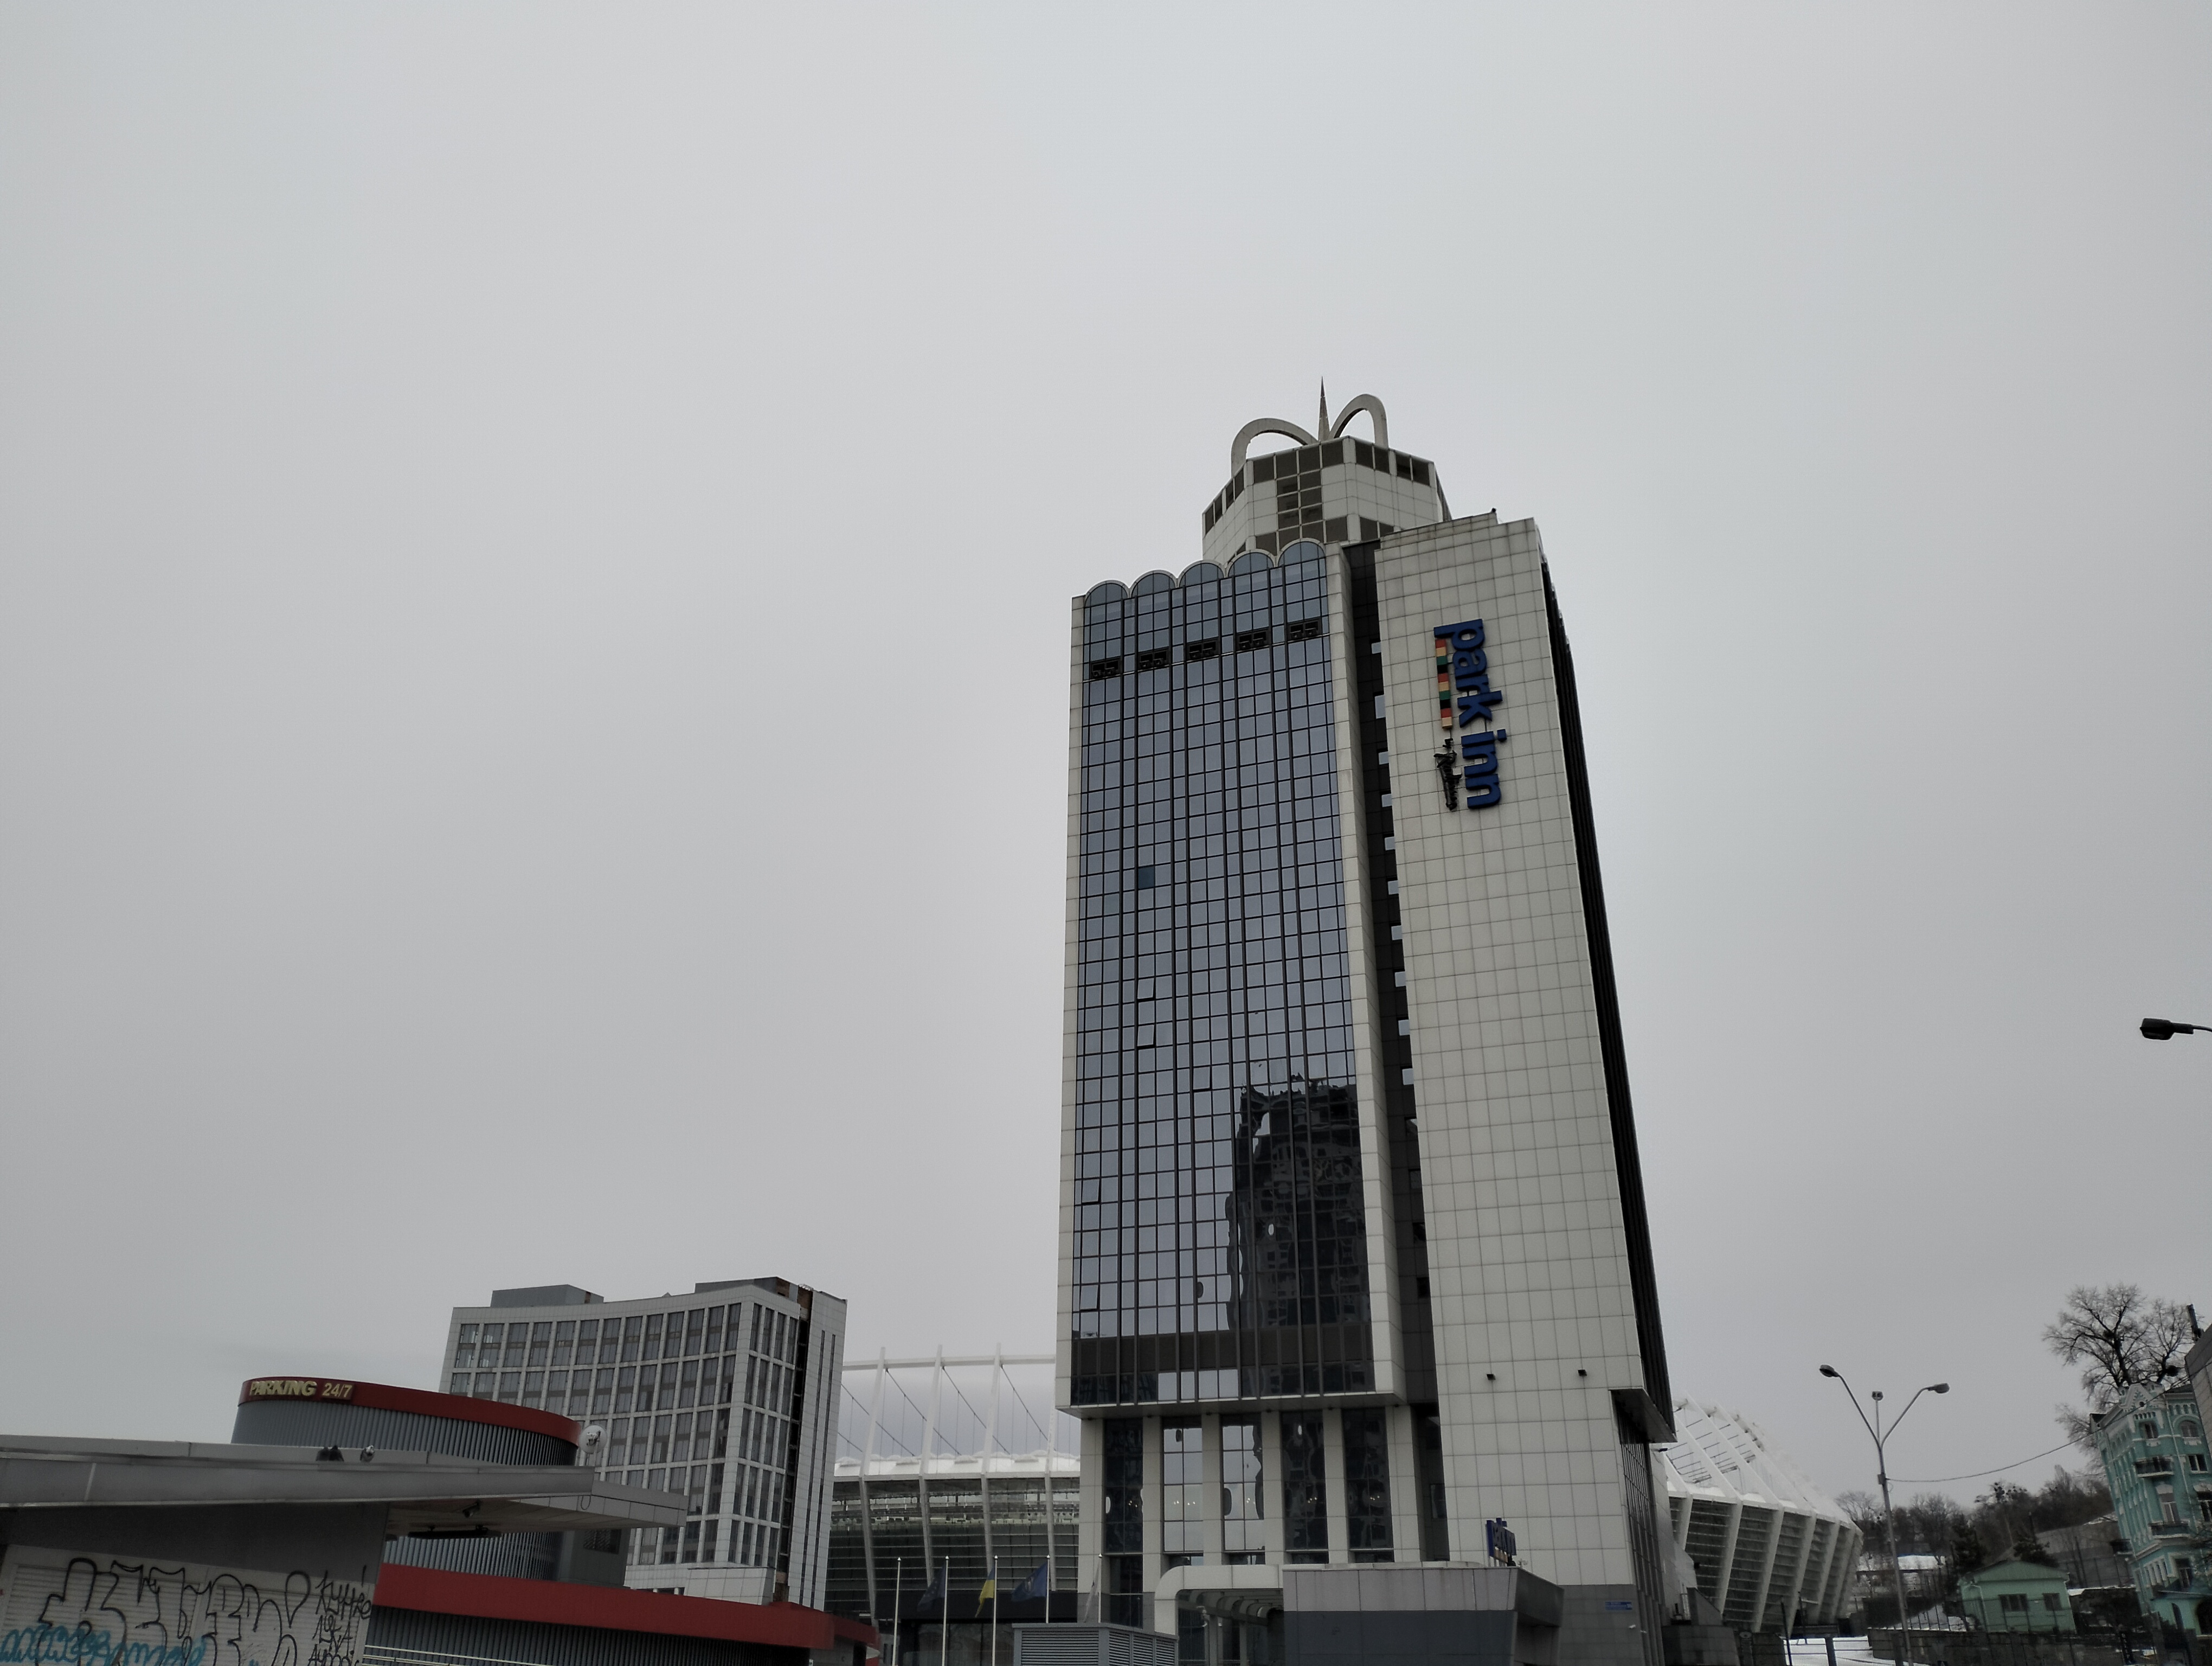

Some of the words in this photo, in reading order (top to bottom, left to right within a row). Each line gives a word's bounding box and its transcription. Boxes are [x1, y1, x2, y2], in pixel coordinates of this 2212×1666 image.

[1433, 619, 1503, 728] park
[1461, 728, 1507, 809] inn
[249, 1380, 317, 1396] PARKING
[322, 1382, 352, 1398] 24/7
